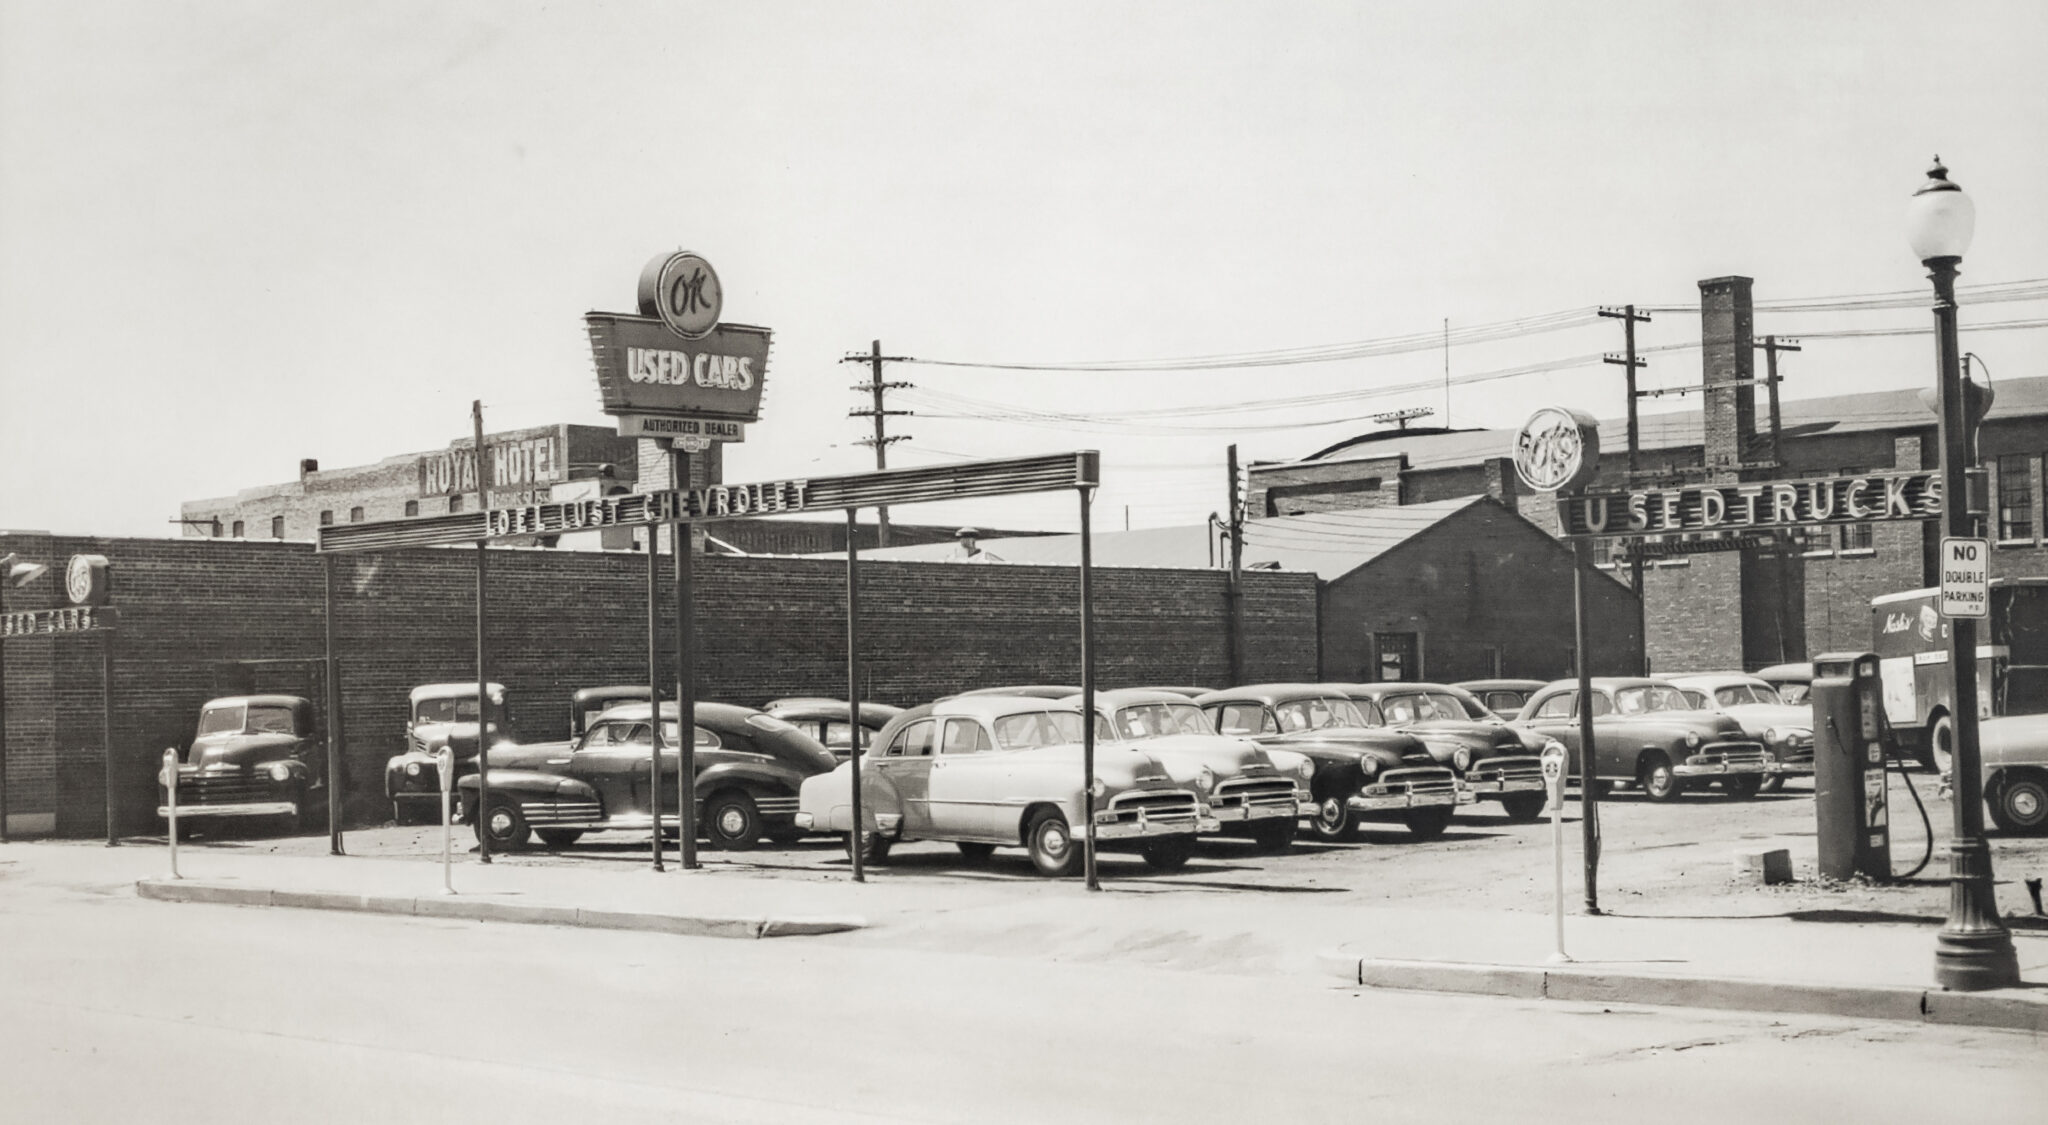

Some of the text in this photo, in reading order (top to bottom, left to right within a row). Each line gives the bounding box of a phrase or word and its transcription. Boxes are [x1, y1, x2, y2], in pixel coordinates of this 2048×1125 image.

[670, 267, 711, 317] OK
[627, 347, 755, 391] USED CARS
[642, 418, 739, 437] AUTHORIZED DEALER
[494, 437, 560, 486] HOTEL
[485, 478, 807, 537] LOEL LUST CHEVROLET
[1584, 474, 1943, 533] USED TRUCKS
[1953, 545, 1977, 561] NO
[1945, 571, 1984, 584] DOUBLE
[1943, 591, 1984, 603] PARKING
[0, 612, 36, 636] SED
